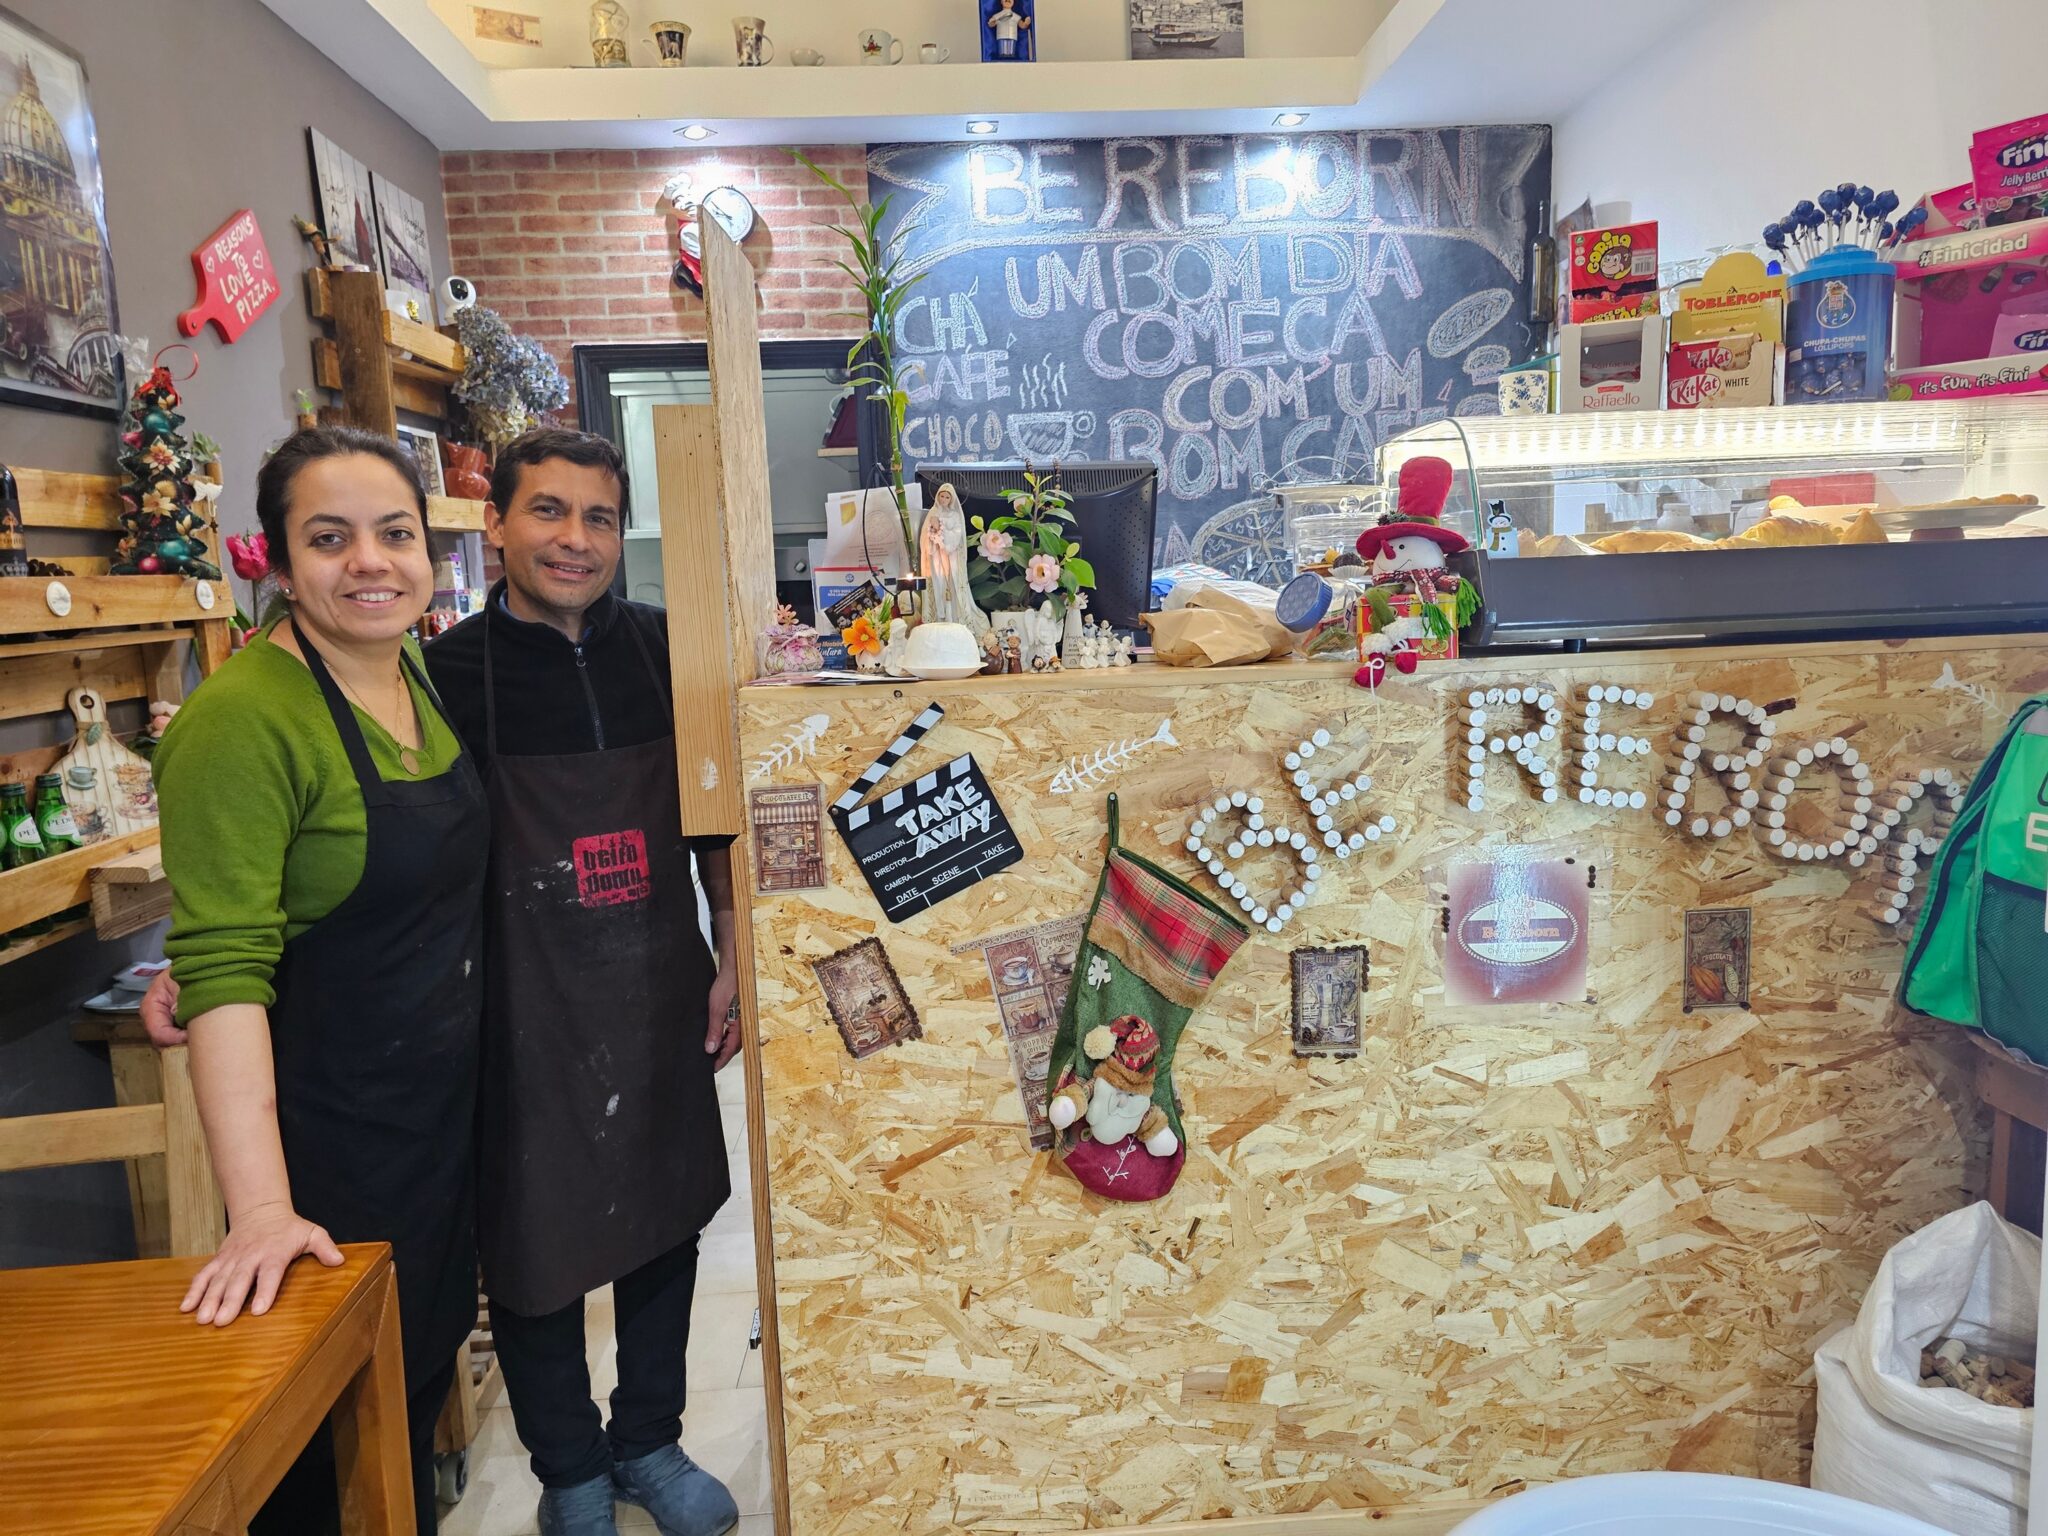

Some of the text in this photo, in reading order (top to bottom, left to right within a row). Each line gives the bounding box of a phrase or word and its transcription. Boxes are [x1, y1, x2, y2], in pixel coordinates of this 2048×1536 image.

[967, 141, 1083, 226] BE
[2001, 174, 2024, 187] Jelly
[214, 215, 254, 263] REASONS
[1919, 233, 2029, 267] #FiniCidad
[231, 252, 245, 270] TO
[220, 263, 254, 304] LOVE
[1005, 228, 1424, 319] UM BOM DIA
[1684, 289, 1782, 312] TOBLERONE
[1804, 335, 1866, 347] CHUPA-CHUPAS
[1814, 343, 1855, 352] LOLLIPOPS
[1675, 374, 1718, 403] KitKat
[1725, 377, 1750, 387] WHITE
[1583, 393, 1640, 408] Raffaello
[902, 410, 1004, 459] CHOCO
[1108, 408, 1265, 499] BOM
[895, 776, 983, 836] TAKE
[915, 800, 991, 858] AWAY
[862, 839, 906, 865] PRODUCTION
[982, 843, 1005, 859] TAKE
[874, 857, 908, 878] DIRECTOR
[931, 865, 961, 886] SCENE
[884, 874, 913, 892] CAMERA
[896, 887, 919, 904] DATE
[1703, 953, 1732, 961] CHOCOLATE
